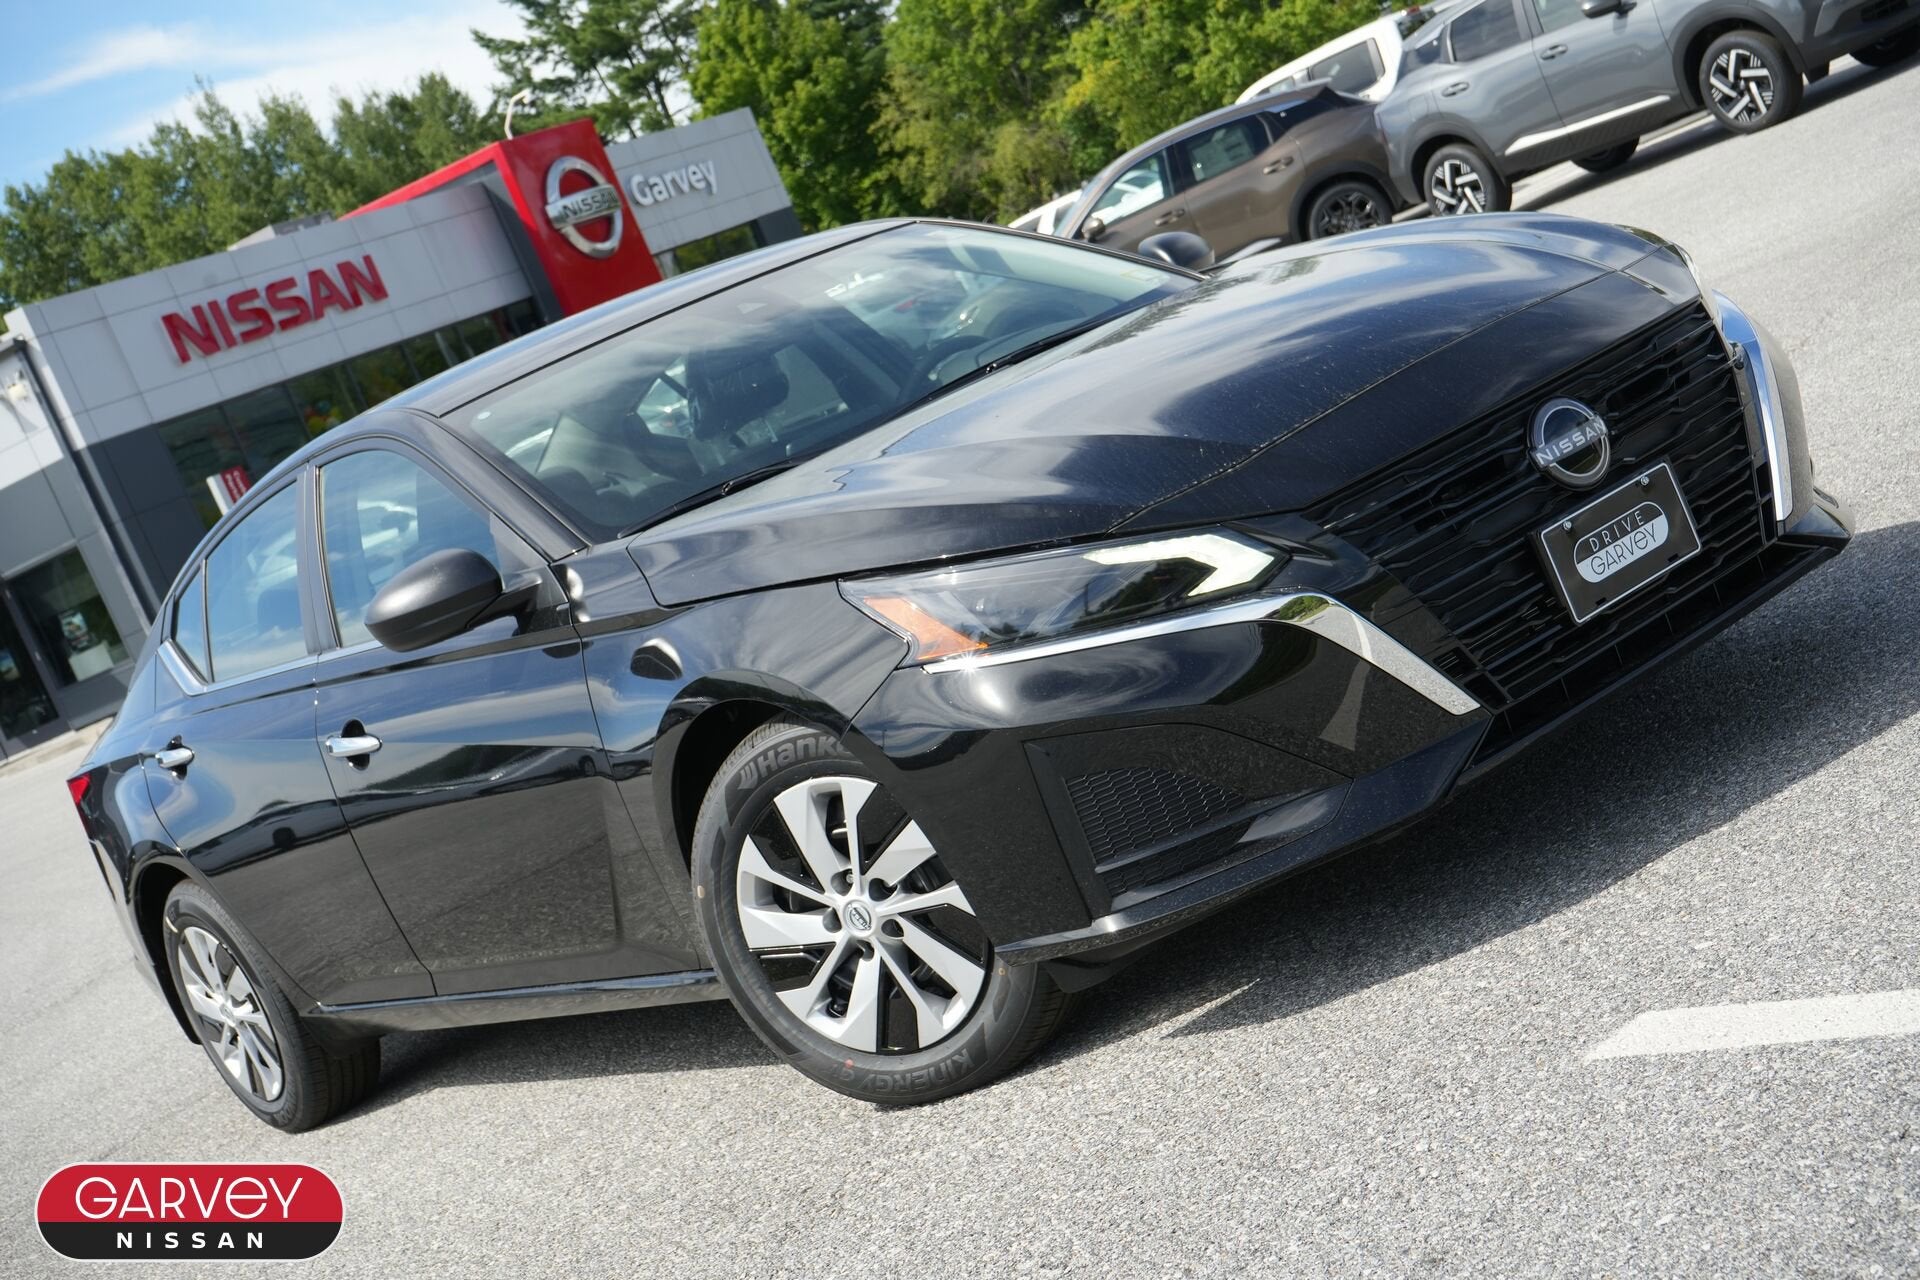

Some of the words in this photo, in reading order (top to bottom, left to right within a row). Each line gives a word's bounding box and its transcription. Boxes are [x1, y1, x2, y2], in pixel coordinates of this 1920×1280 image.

[630, 158, 719, 206] Garvey
[161, 254, 389, 365] NISSAN
[1535, 418, 1608, 465] NISSAN
[1589, 510, 1645, 553] DRIVE
